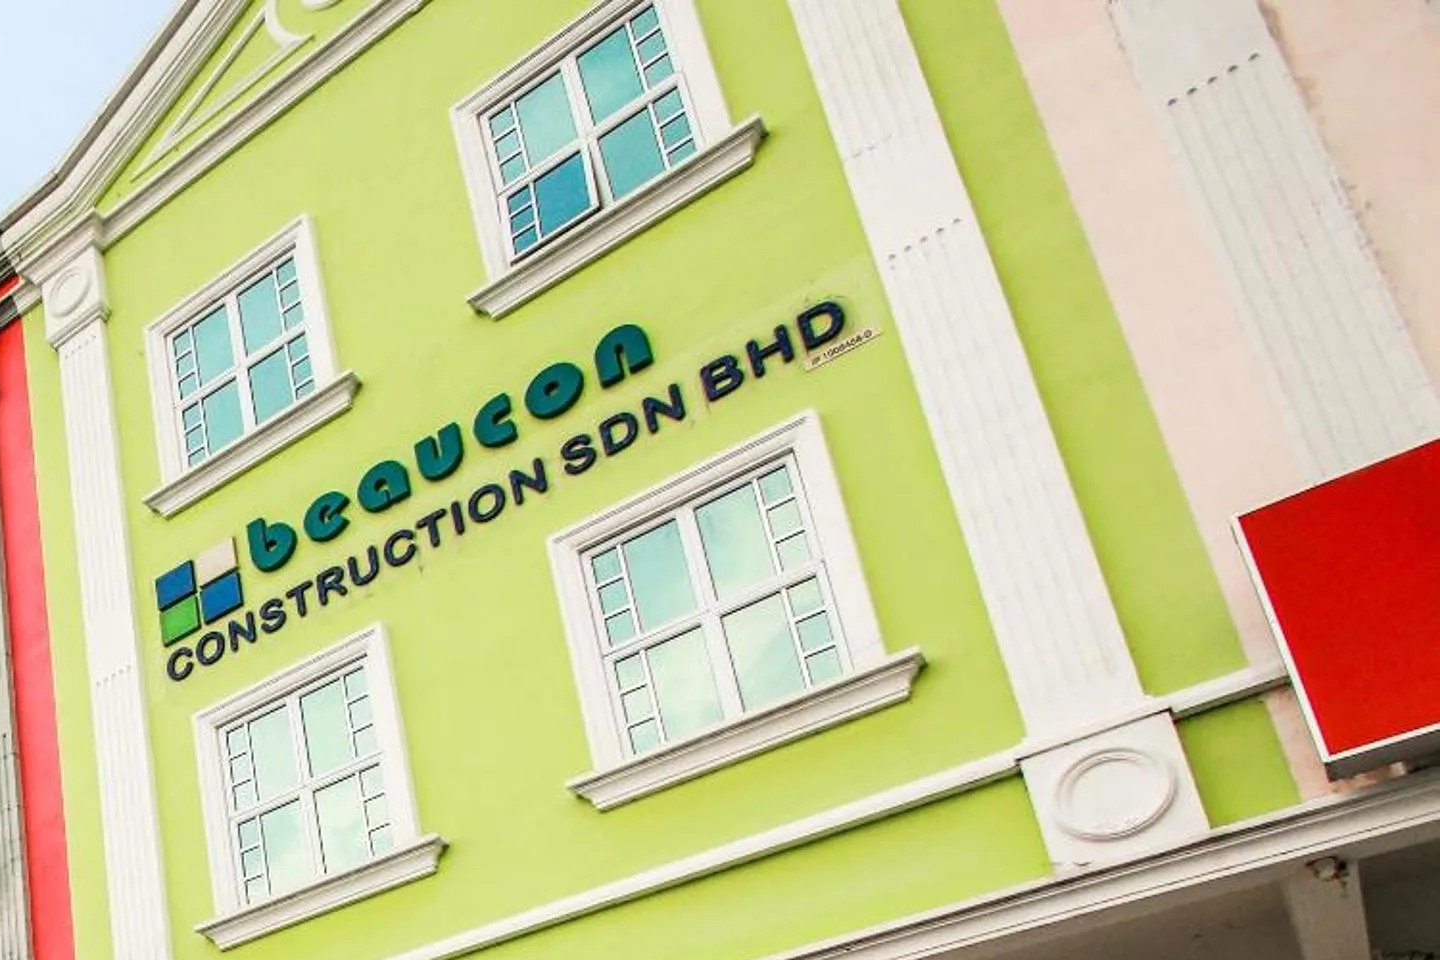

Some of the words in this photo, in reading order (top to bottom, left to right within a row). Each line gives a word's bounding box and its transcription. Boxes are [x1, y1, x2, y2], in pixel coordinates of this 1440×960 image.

[166, 458, 549, 681] CONSTRUCTION
[564, 382, 687, 475] SDN
[700, 300, 846, 402] BHD
